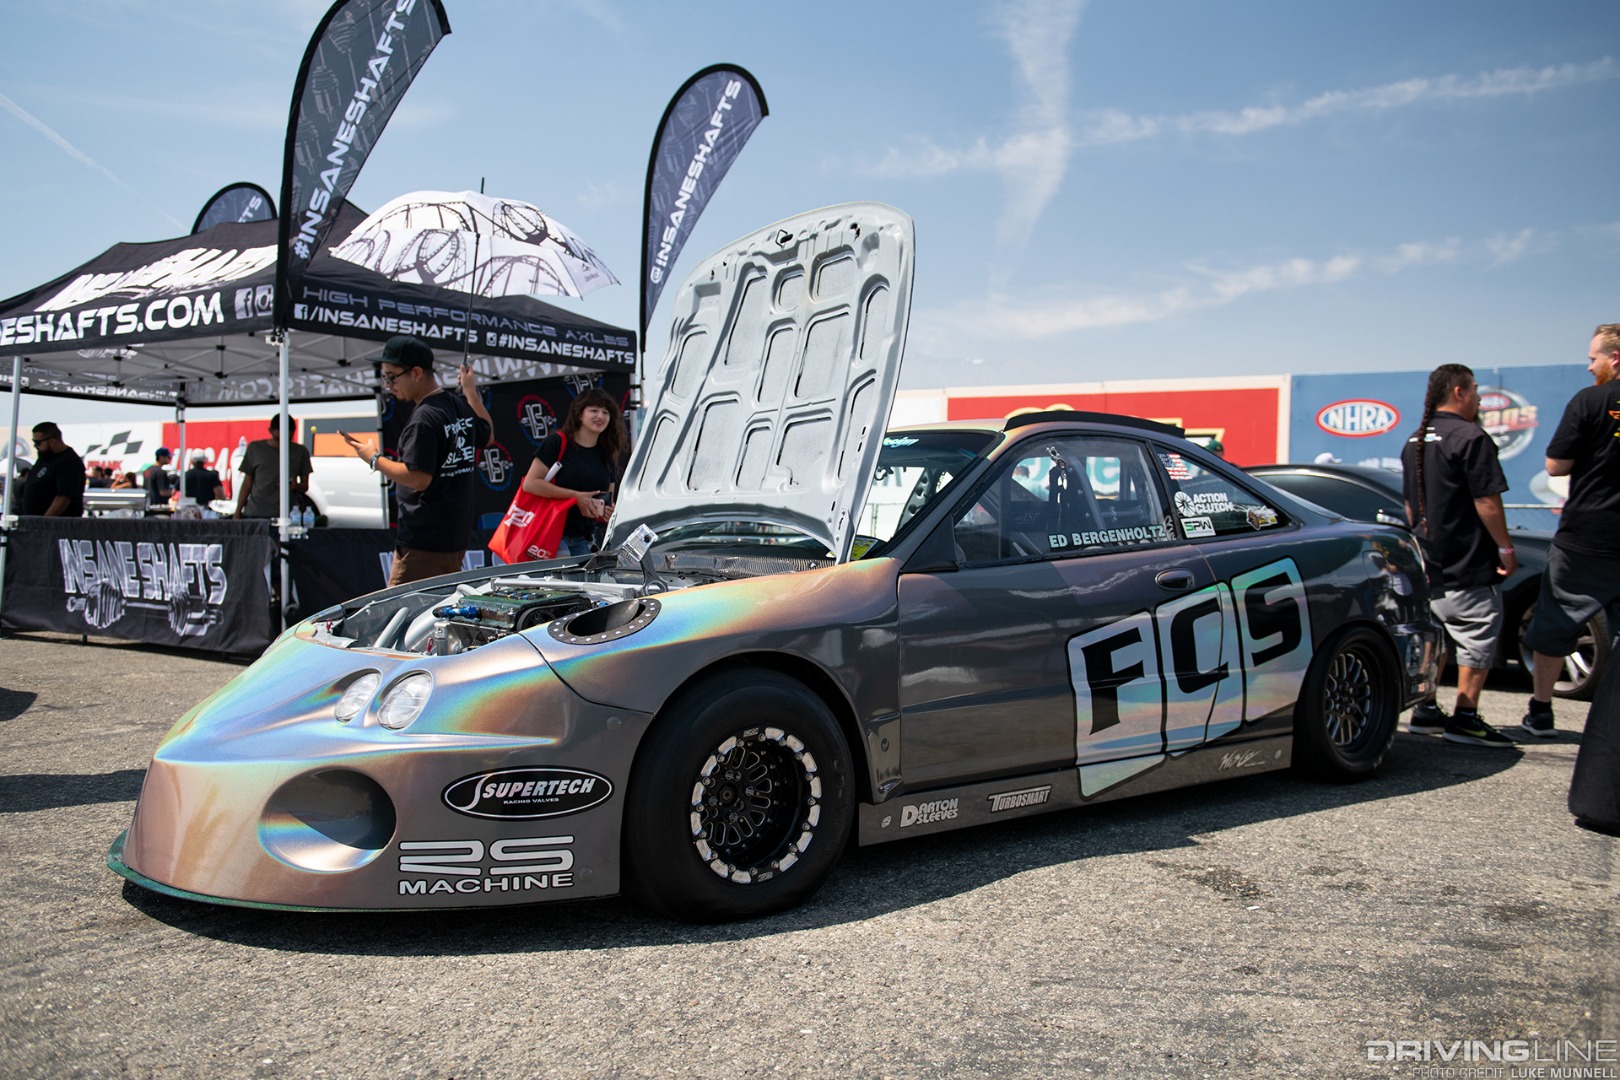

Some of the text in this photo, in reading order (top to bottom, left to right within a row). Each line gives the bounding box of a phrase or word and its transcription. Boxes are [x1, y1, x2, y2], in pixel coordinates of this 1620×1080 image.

[294, 0, 416, 259] #INSANESHAFTS
[650, 79, 742, 284] @INSANESHAFTS
[0, 291, 224, 346] ESHAFTS.COM
[303, 286, 629, 347] HIGH PERFORMANCE AXLES
[498, 332, 635, 365] #INSANESHAFTS
[1327, 407, 1391, 432] NHRA
[1193, 493, 1228, 504] ACTION
[1195, 502, 1233, 515] CLUTCH
[1049, 524, 1166, 548] ED BERGENHOLTZ
[136, 542, 229, 605] SHAFTS
[482, 778, 596, 799] SUPERTECH
[988, 785, 1052, 812] TURBOSMART
[900, 797, 959, 828] DARTON
[916, 808, 959, 825] SLEEVES
[399, 872, 574, 895] MACHINE
